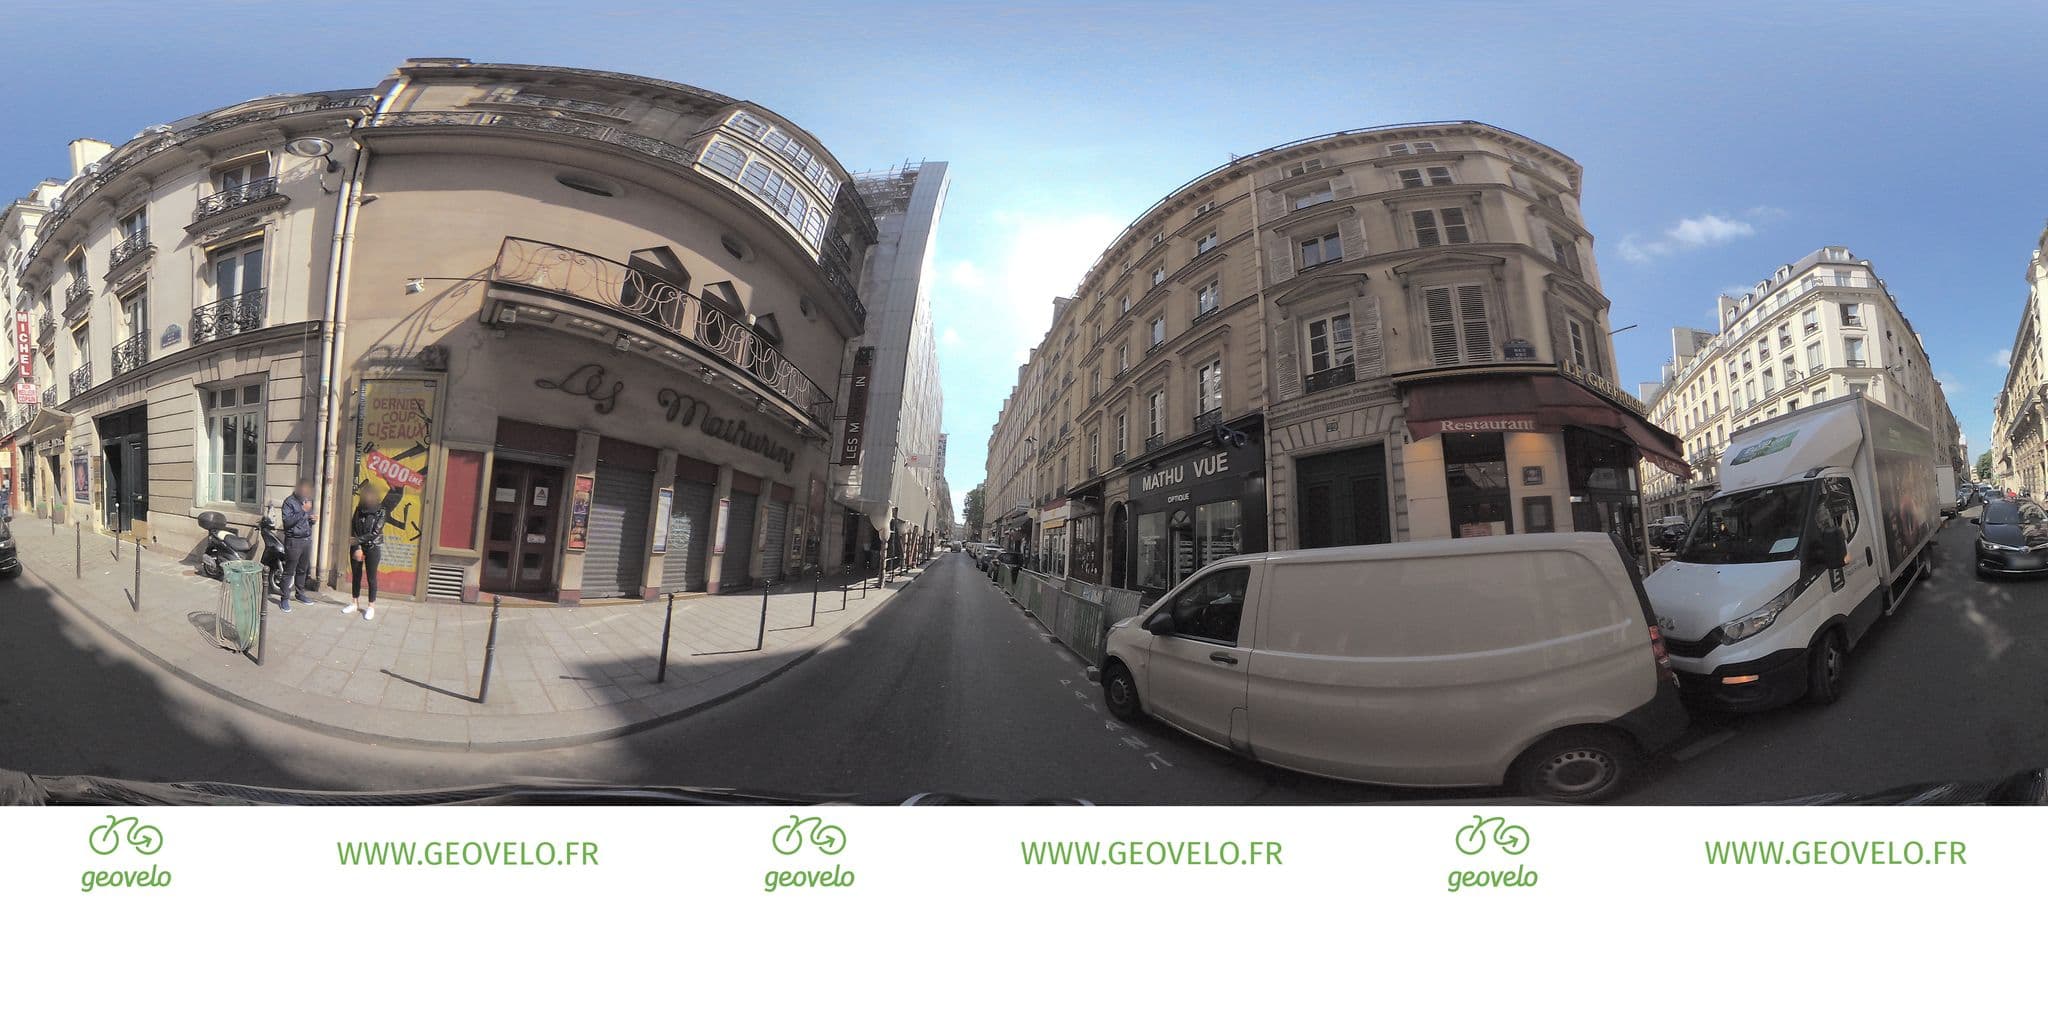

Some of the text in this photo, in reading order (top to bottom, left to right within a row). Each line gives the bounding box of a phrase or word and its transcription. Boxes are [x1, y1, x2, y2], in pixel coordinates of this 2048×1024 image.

[17, 313, 30, 376] MICHEL
[1562, 359, 1584, 380] LE
[534, 363, 624, 415] Les
[373, 398, 426, 411] DERNIER
[382, 411, 416, 424] COUP
[1440, 420, 1536, 432] Restaurant
[367, 422, 425, 440] CISEAUX
[845, 438, 858, 459] LES
[1142, 452, 1229, 491] MATHU VUE
[1167, 493, 1190, 503] OPTIQUE
